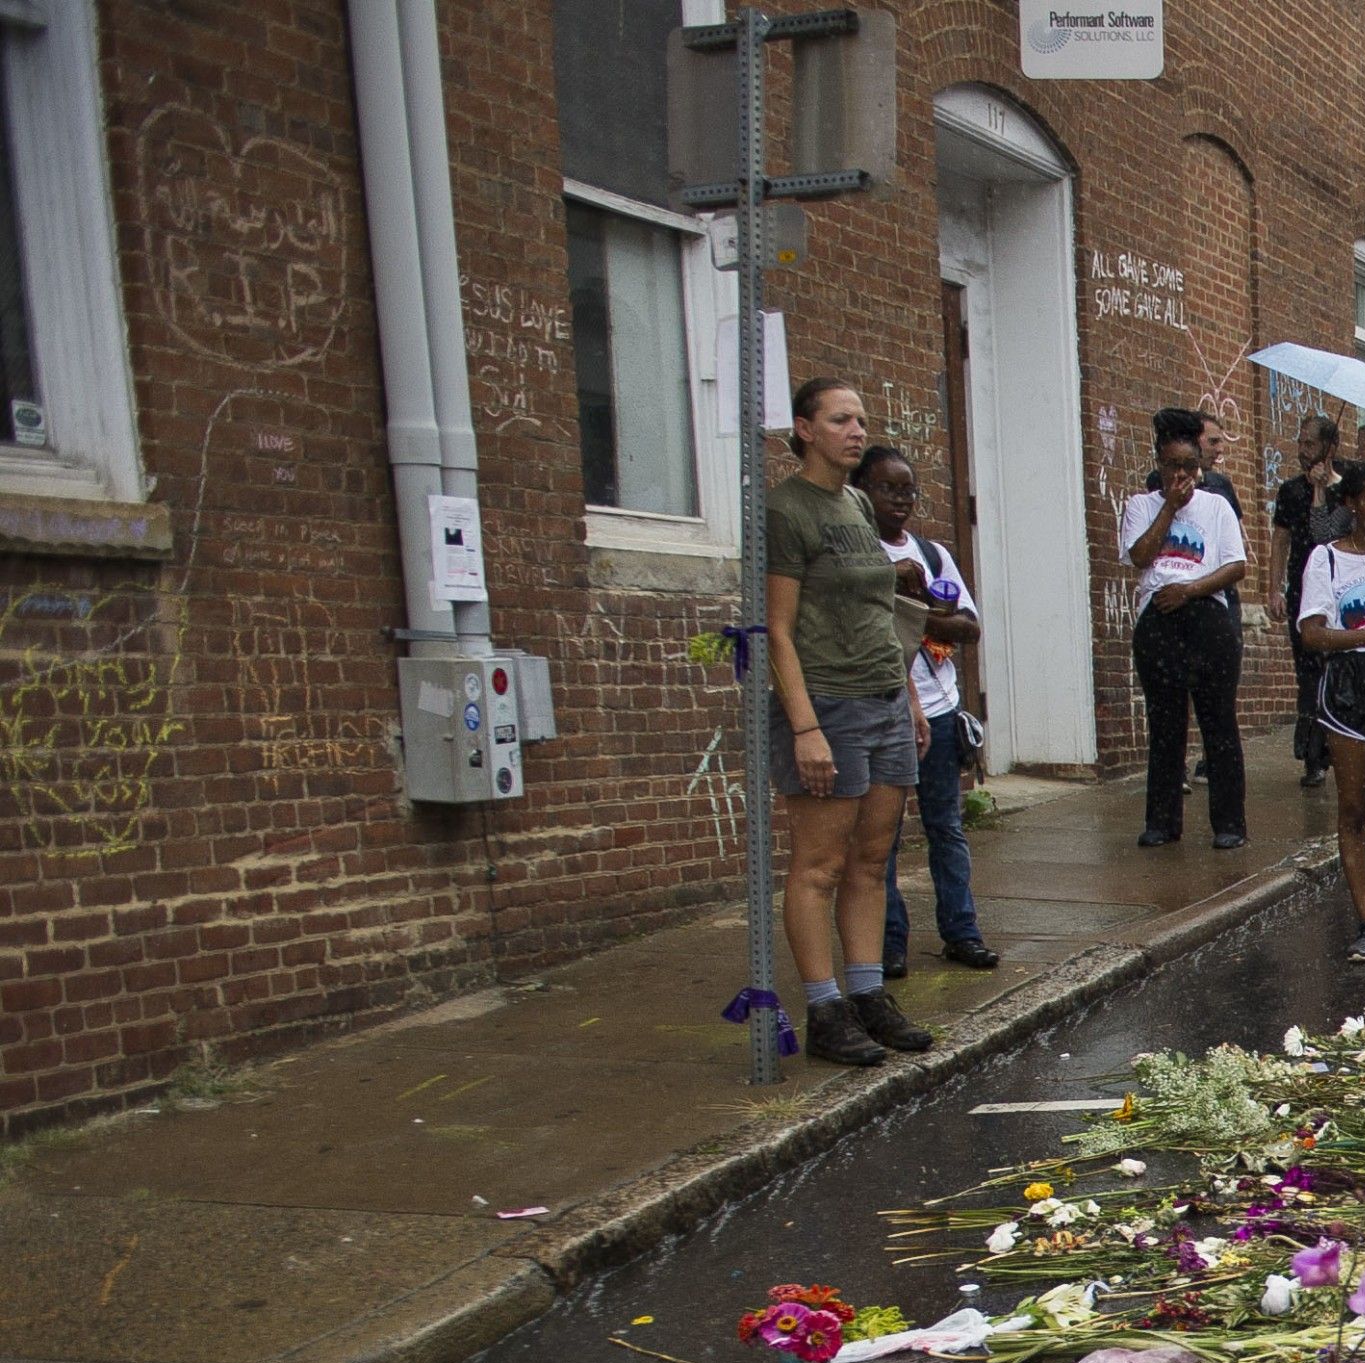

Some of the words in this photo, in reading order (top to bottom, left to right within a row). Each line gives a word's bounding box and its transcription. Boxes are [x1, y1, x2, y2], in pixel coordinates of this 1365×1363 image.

[1050, 11, 1105, 28] Performant
[1108, 11, 1155, 28] Software
[1074, 31, 1134, 43] SOLUTIONS,
[1136, 31, 1155, 42] LLC
[1092, 250, 1115, 279] ALL
[1118, 252, 1150, 286] GAVE
[1152, 262, 1185, 292] SOME
[1095, 286, 1131, 321] SOME
[1134, 293, 1162, 321] GAVE
[1163, 298, 1188, 330] ALL
[273, 466, 296, 482] YOU
